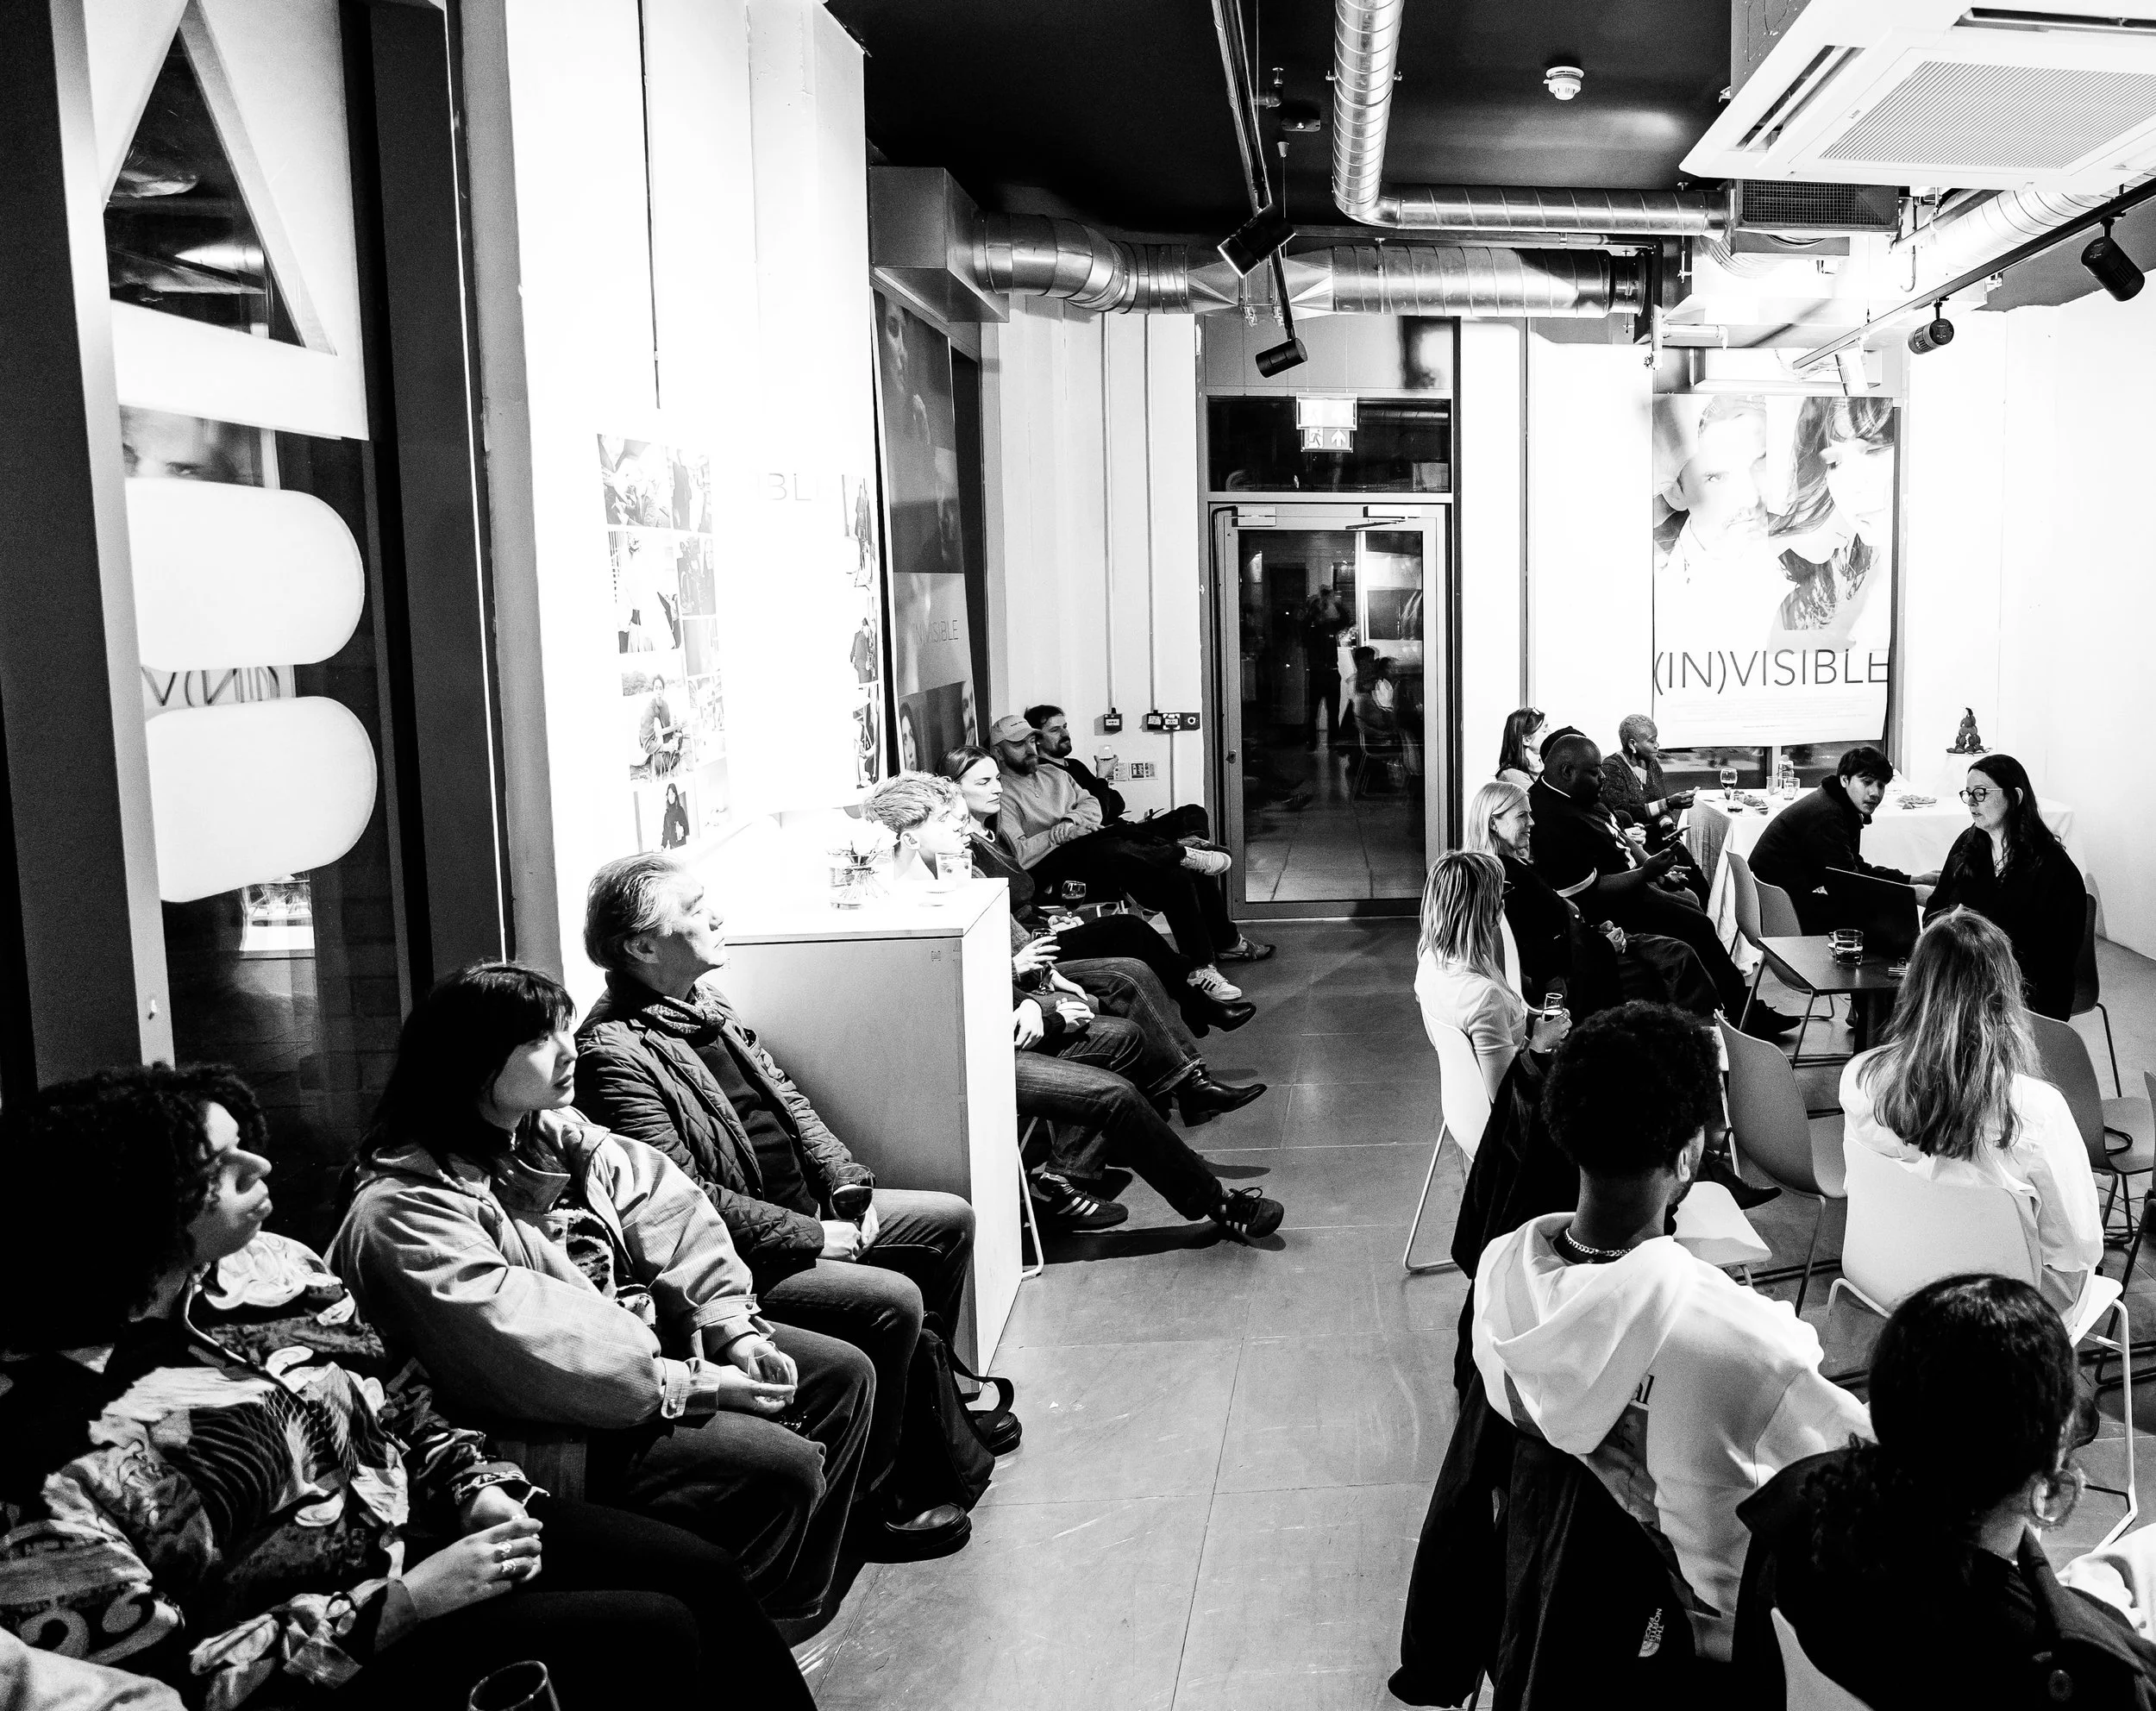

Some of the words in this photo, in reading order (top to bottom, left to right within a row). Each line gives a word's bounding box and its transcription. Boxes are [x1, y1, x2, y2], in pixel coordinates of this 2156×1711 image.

[1653, 649, 1889, 695] (IN)VISIBLE
[1644, 1616, 1655, 1642] FACE
[1649, 1608, 1663, 1642] NORTH
[1655, 1625, 1664, 1644] THE
